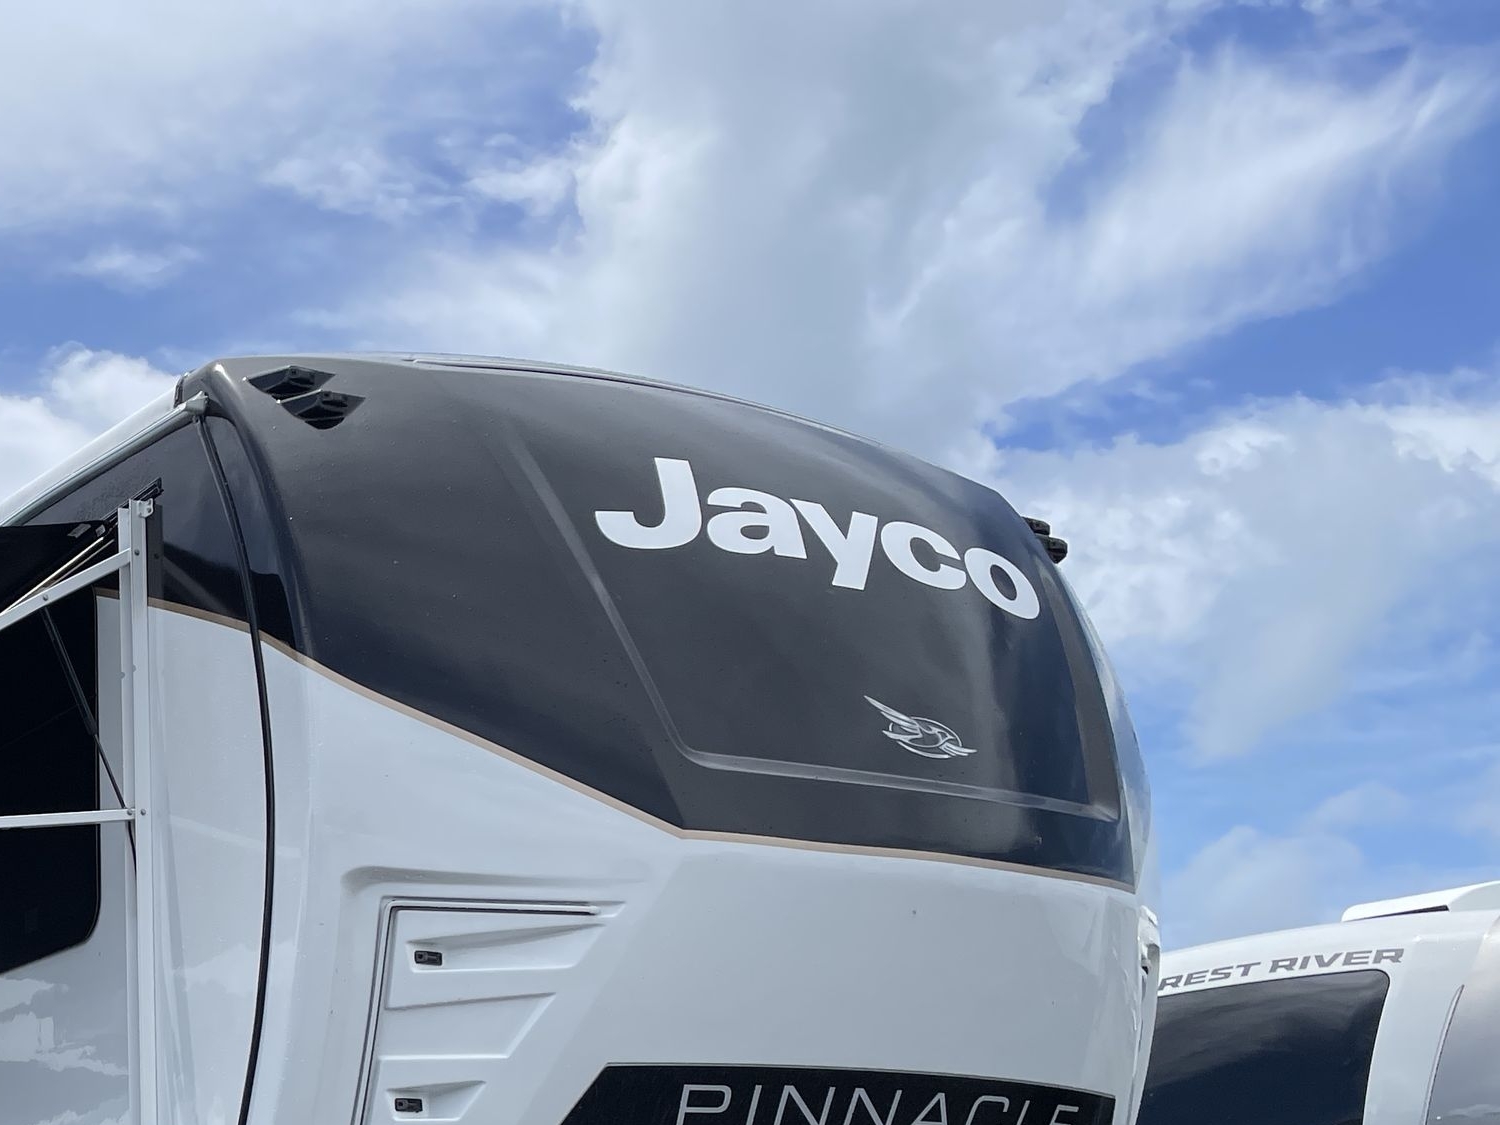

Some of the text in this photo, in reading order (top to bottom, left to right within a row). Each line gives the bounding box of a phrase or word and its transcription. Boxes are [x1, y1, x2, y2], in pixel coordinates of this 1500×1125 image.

[595, 457, 1040, 620] Jayco
[1158, 948, 1405, 991] REST RIVER
